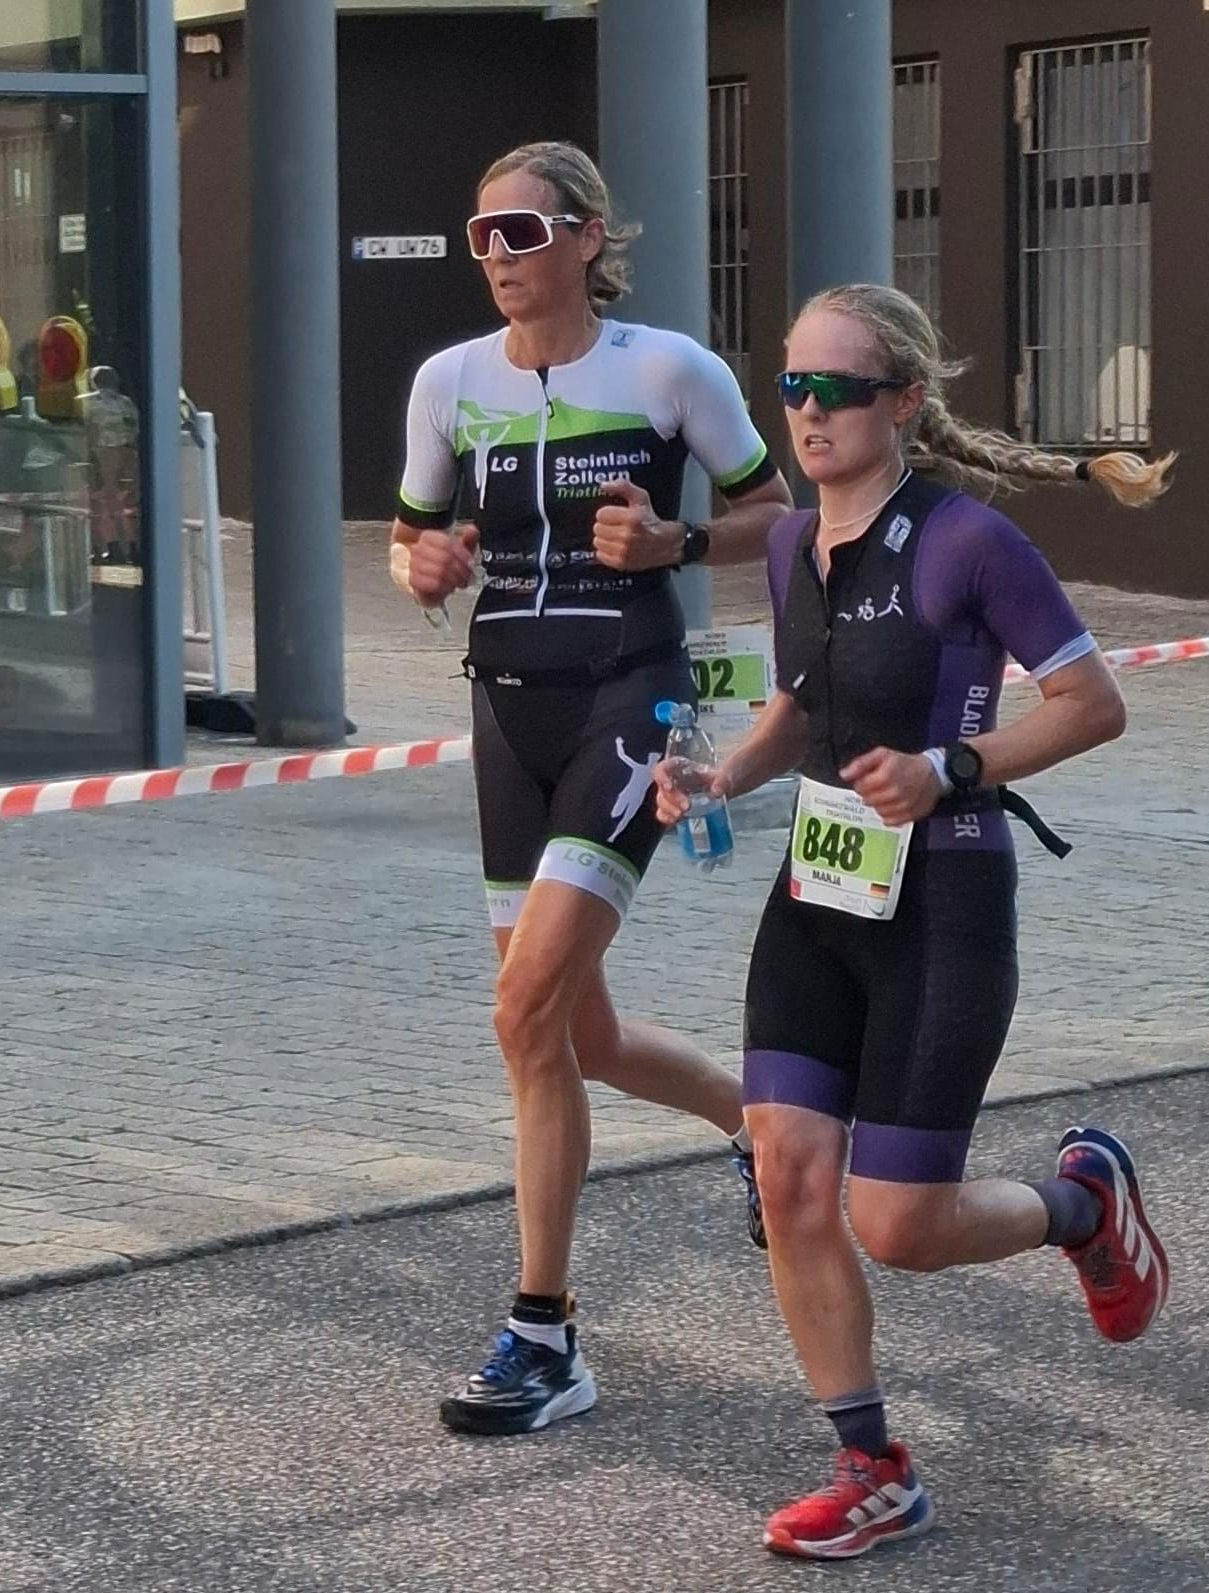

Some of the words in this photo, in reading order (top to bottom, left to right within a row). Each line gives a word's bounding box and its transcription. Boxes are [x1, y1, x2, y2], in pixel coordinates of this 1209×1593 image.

[490, 456, 519, 472] LG
[554, 450, 651, 471] Steinlach
[553, 470, 630, 486] Zollern
[802, 816, 866, 873] 848
[811, 869, 842, 886] MANJA
